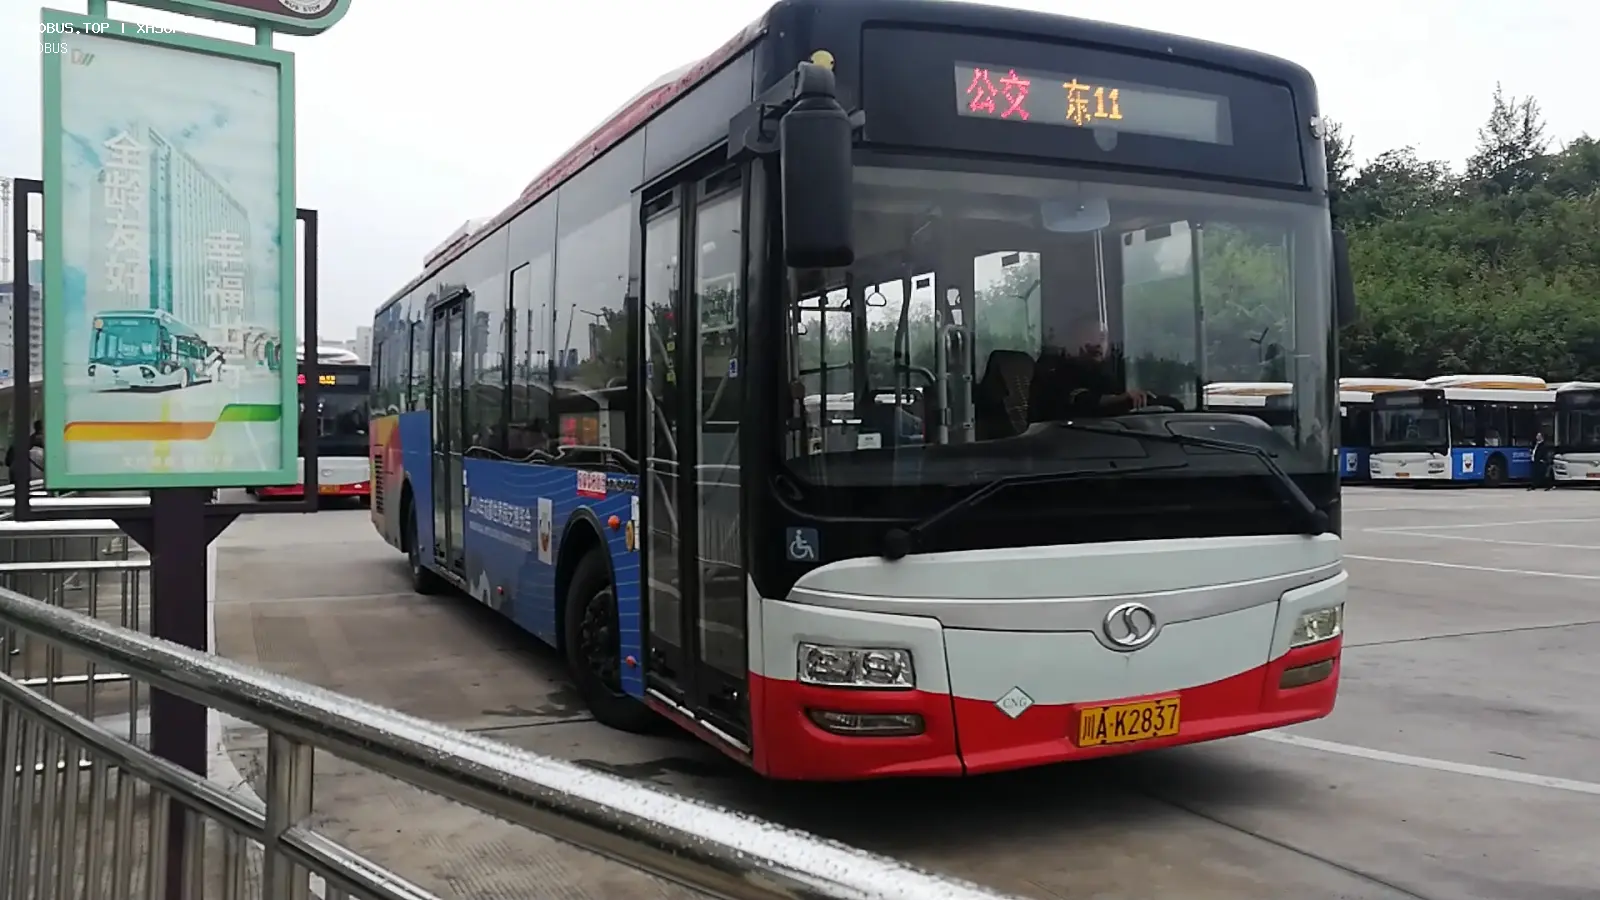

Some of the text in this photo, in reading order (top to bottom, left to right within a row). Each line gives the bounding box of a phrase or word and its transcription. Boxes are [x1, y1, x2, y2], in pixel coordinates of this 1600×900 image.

[967, 67, 1123, 126] 公交 东11
[103, 130, 147, 295] 全龄友好
[1002, 696, 1028, 708] CNG
